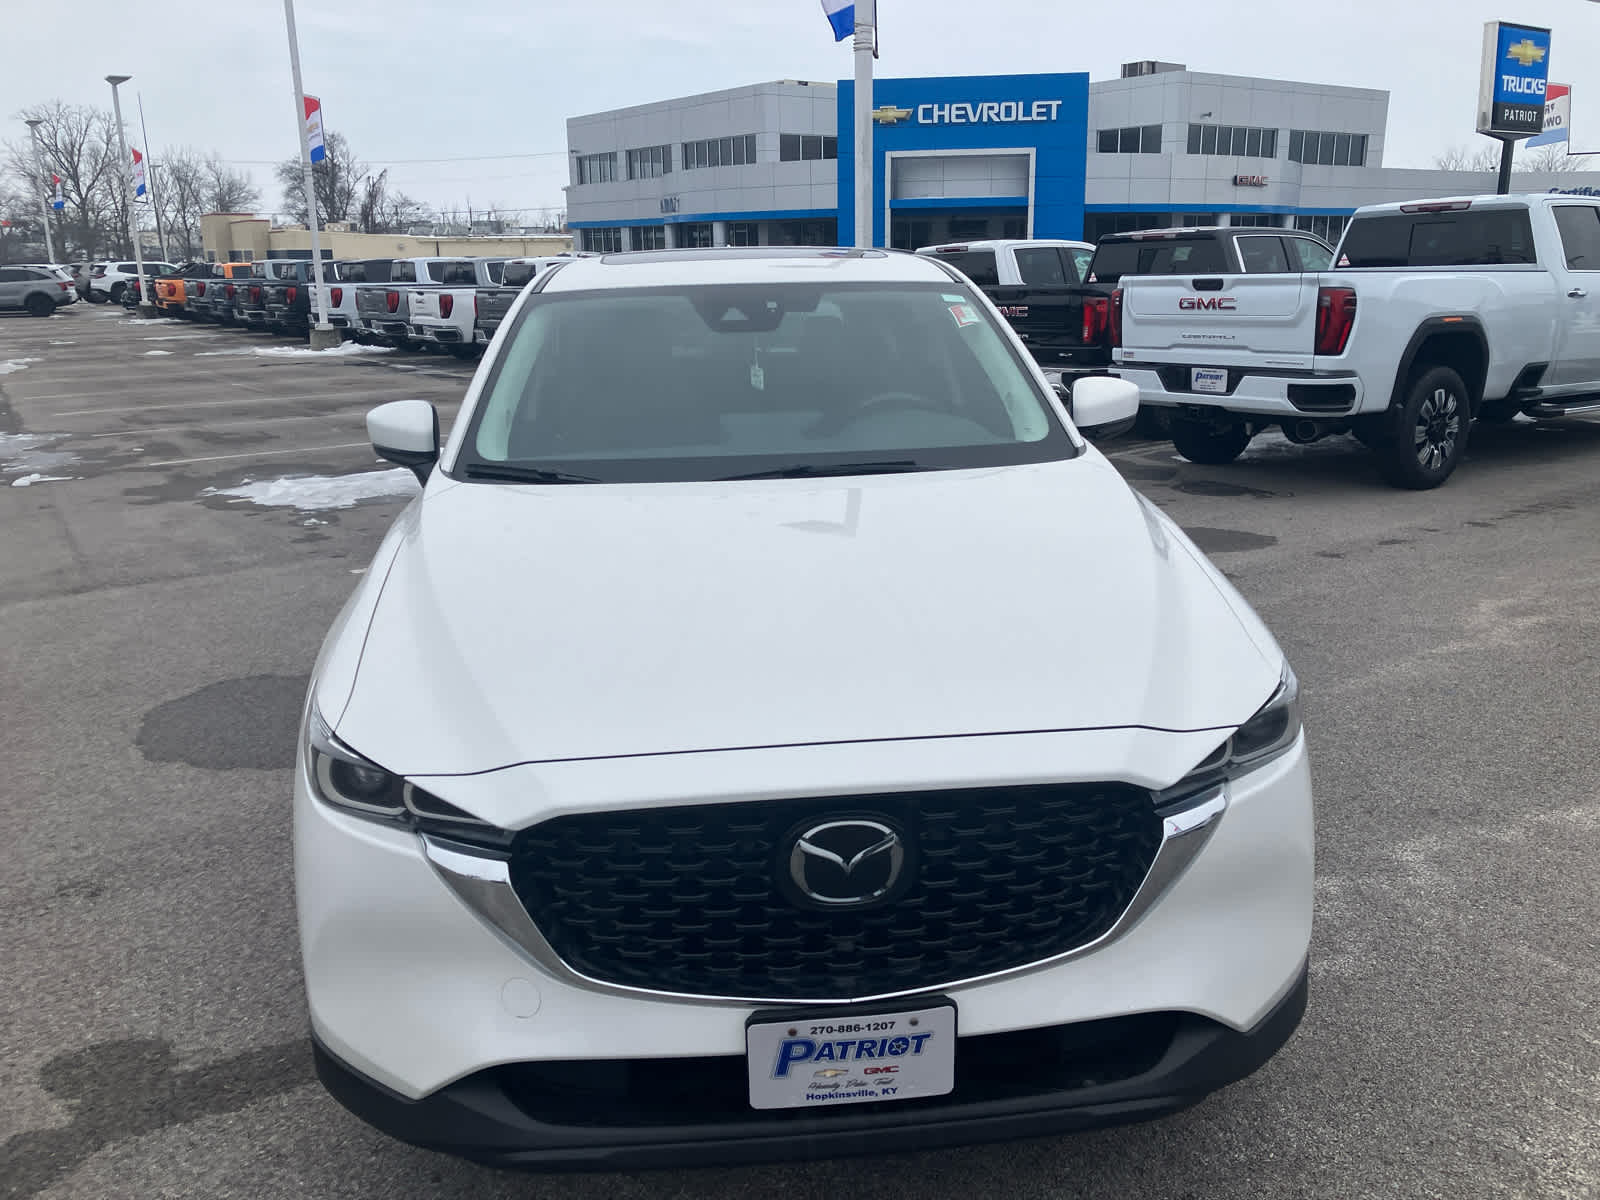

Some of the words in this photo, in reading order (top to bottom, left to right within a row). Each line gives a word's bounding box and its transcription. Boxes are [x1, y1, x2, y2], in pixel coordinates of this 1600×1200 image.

[1502, 75, 1546, 95] TRUCKS
[918, 100, 1062, 124] CHEVROLET
[1504, 109, 1538, 122] PATRIOT
[1179, 297, 1237, 310] GMC
[996, 306, 1029, 317] MC
[810, 1021, 896, 1035] 270-886-1207
[772, 1032, 934, 1080] PATRIOT
[863, 1065, 899, 1075] GMC
[806, 1089, 878, 1101] Hopkinsville,
[881, 1087, 898, 1096] KY
